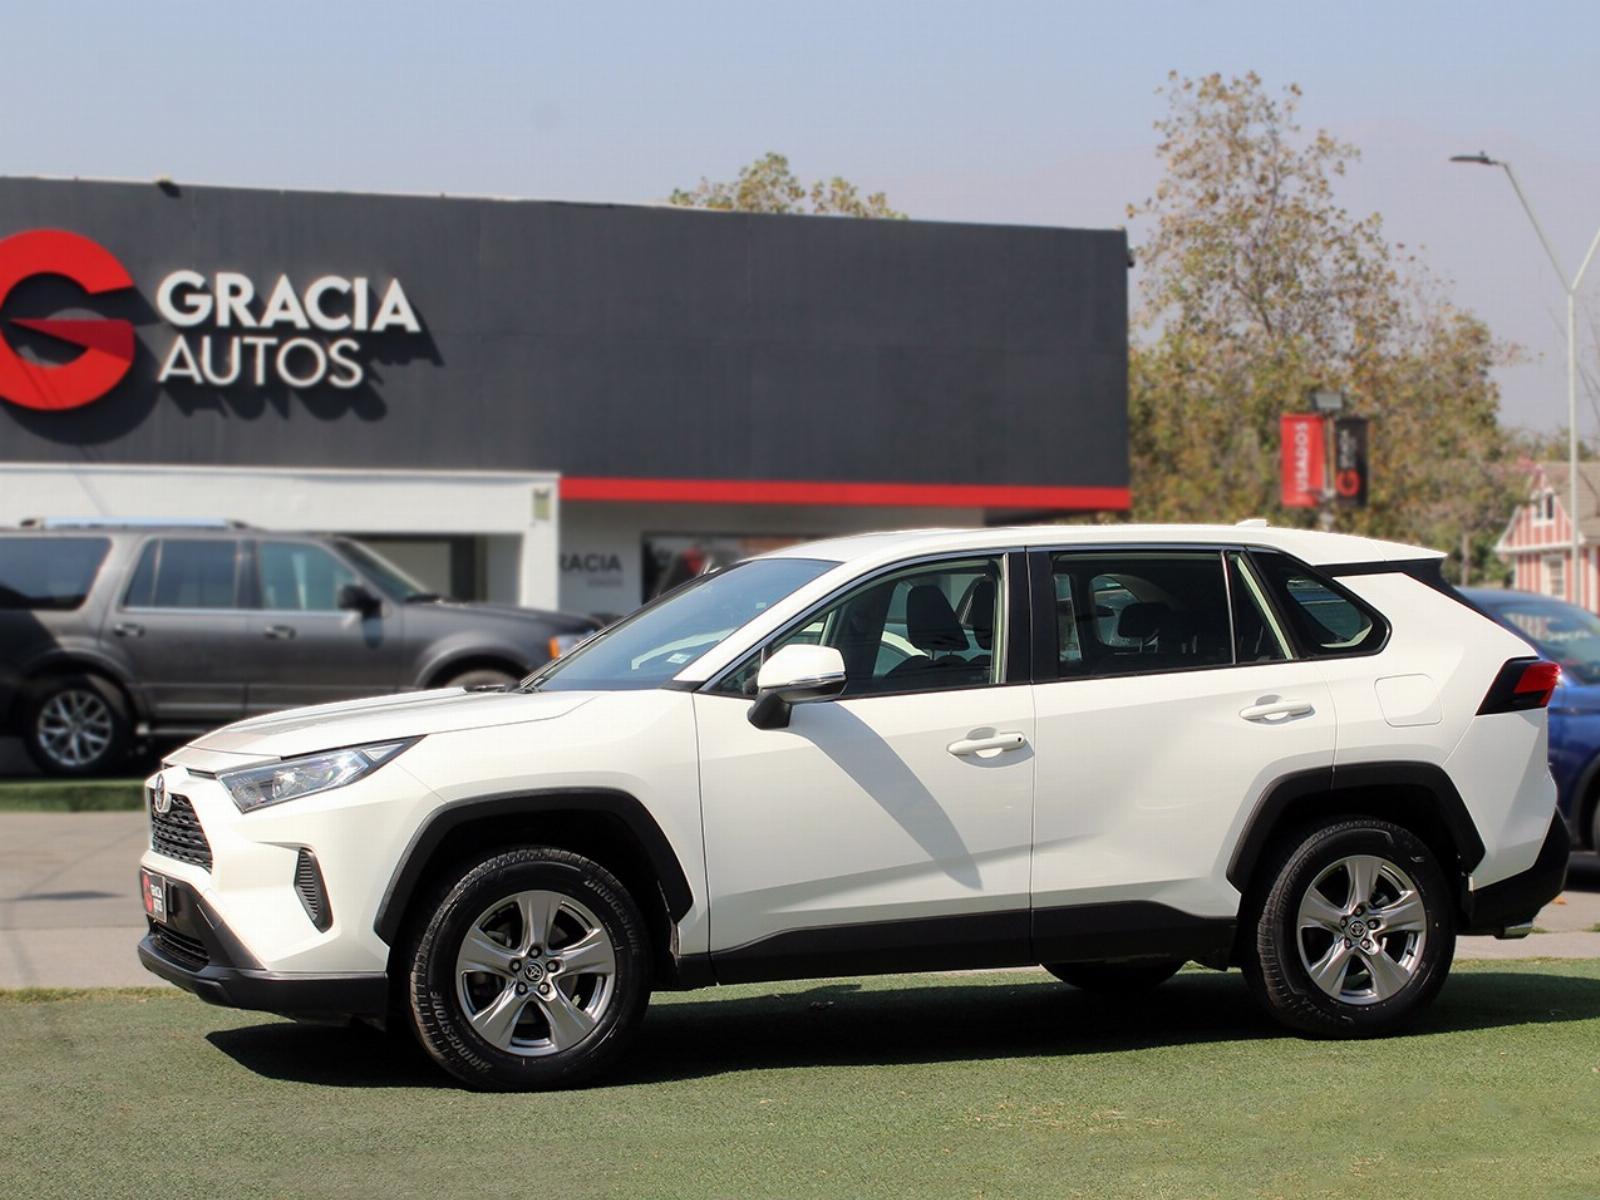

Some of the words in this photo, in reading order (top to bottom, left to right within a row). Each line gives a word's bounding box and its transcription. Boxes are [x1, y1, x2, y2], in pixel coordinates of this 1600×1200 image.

[0, 229, 135, 411] G
[157, 269, 421, 332] GRACIA
[158, 334, 363, 388] AUTOS
